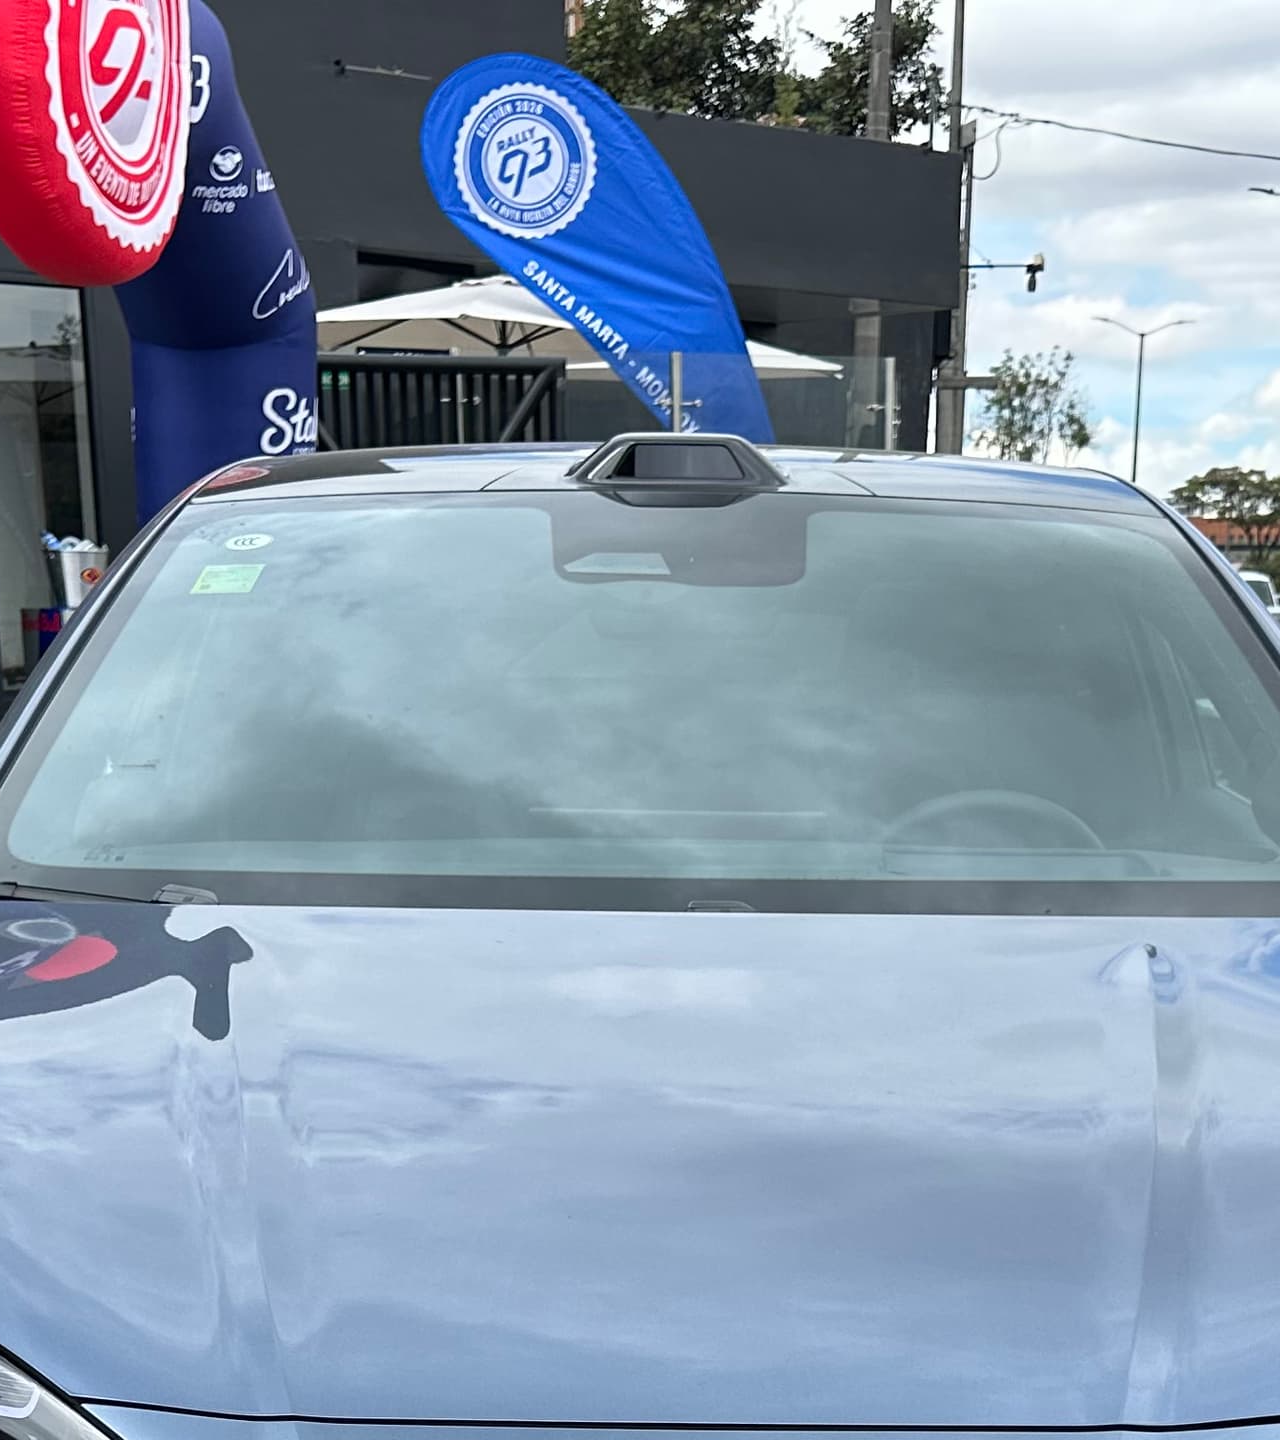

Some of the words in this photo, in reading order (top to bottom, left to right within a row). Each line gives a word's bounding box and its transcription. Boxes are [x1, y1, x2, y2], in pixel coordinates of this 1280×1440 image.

[496, 126, 537, 154] RALLY
[498, 136, 552, 198] 93
[192, 184, 249, 198] mercado
[202, 199, 236, 213] libre
[522, 259, 577, 311] SANTA
[574, 304, 630, 361] MARTA
